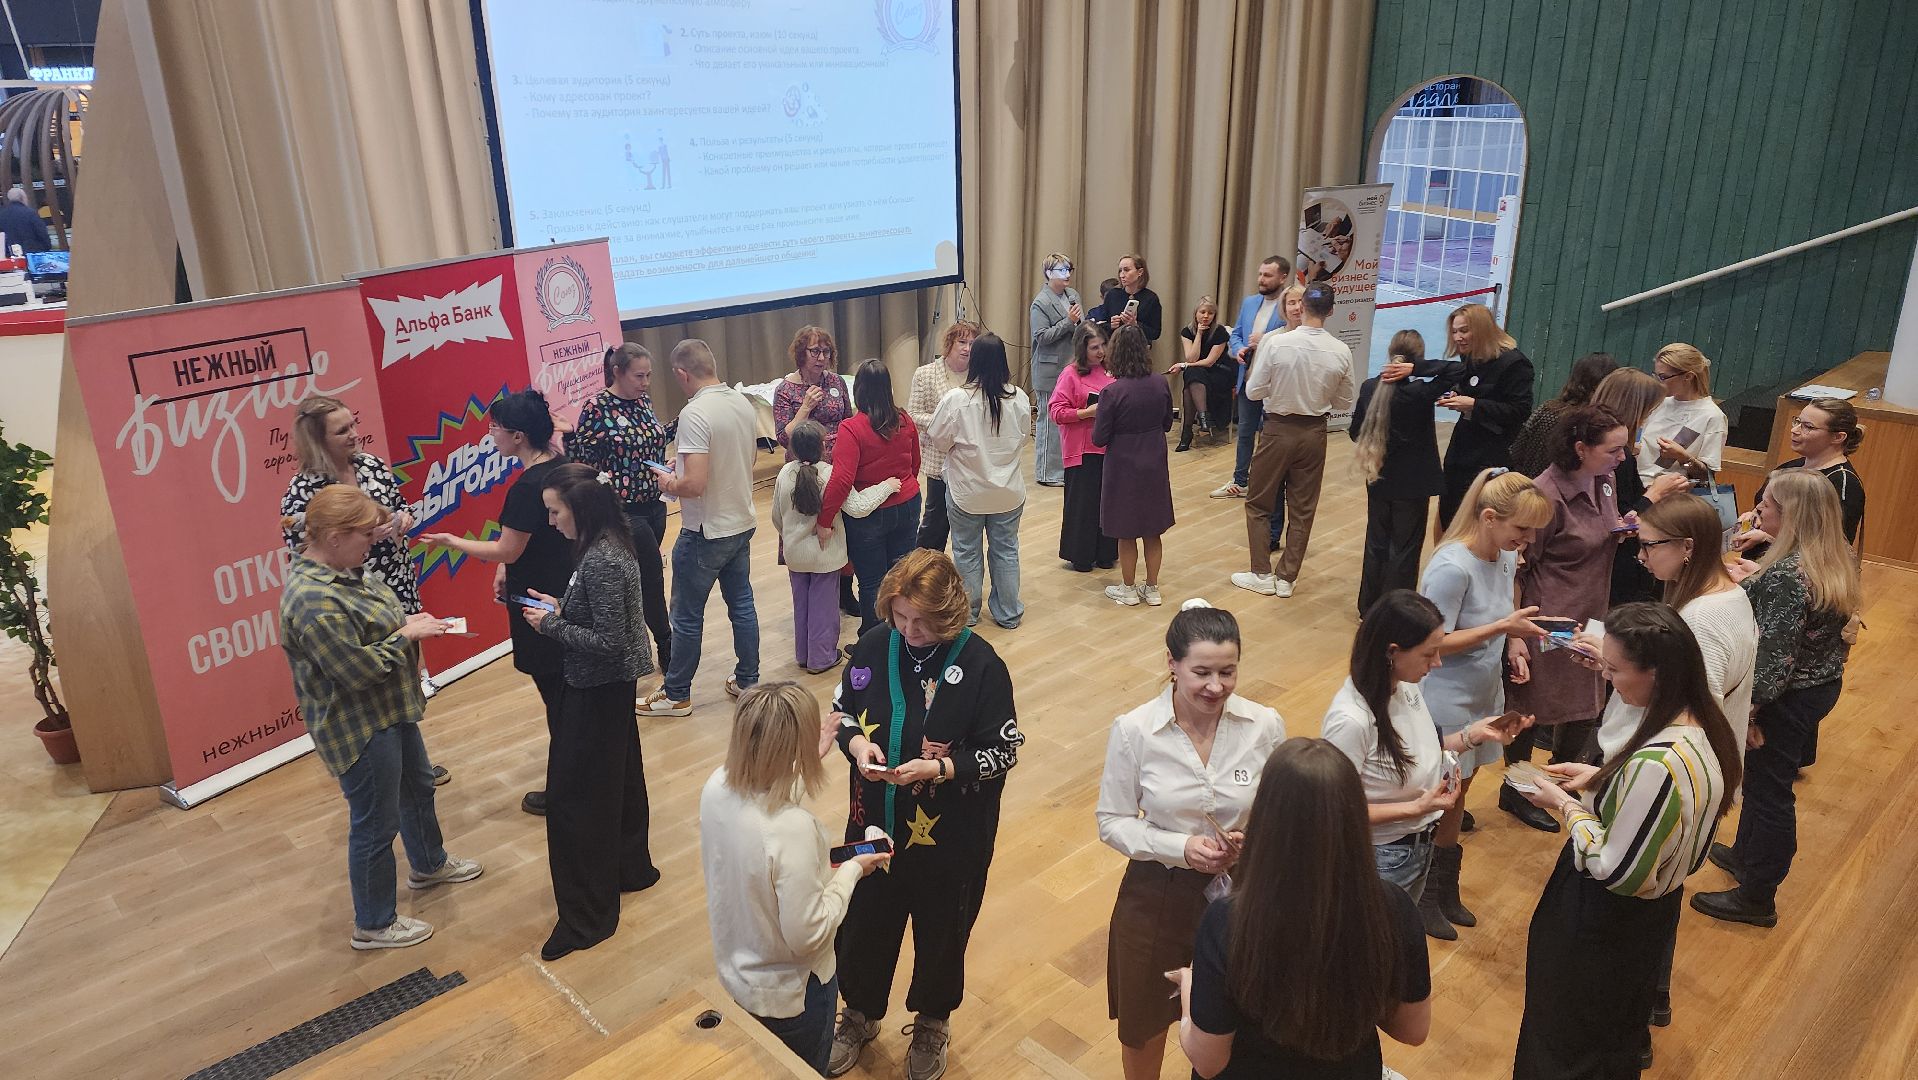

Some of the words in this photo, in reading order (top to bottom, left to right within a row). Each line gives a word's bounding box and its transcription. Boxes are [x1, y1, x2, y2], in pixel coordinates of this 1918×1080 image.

[29, 67, 95, 81] ФРАНКЛ
[1424, 83, 1460, 94] есторан
[529, 210, 541, 222] 5.
[546, 223, 585, 236] Призыв
[612, 268, 645, 279] оздать
[647, 260, 706, 276] возможность
[1355, 259, 1379, 272] Мой
[1331, 273, 1369, 283] бизнес
[1331, 282, 1376, 295] будущее
[395, 310, 451, 343] Альфа
[453, 302, 494, 324] Банк
[553, 340, 590, 360] НЕЖНЫЙ
[172, 340, 277, 387] НЕЖНЫЙ
[557, 366, 604, 395] Пушкински
[213, 545, 293, 605] ОТКР
[203, 703, 303, 764] нежныйб
[1234, 769, 1249, 783] 63
